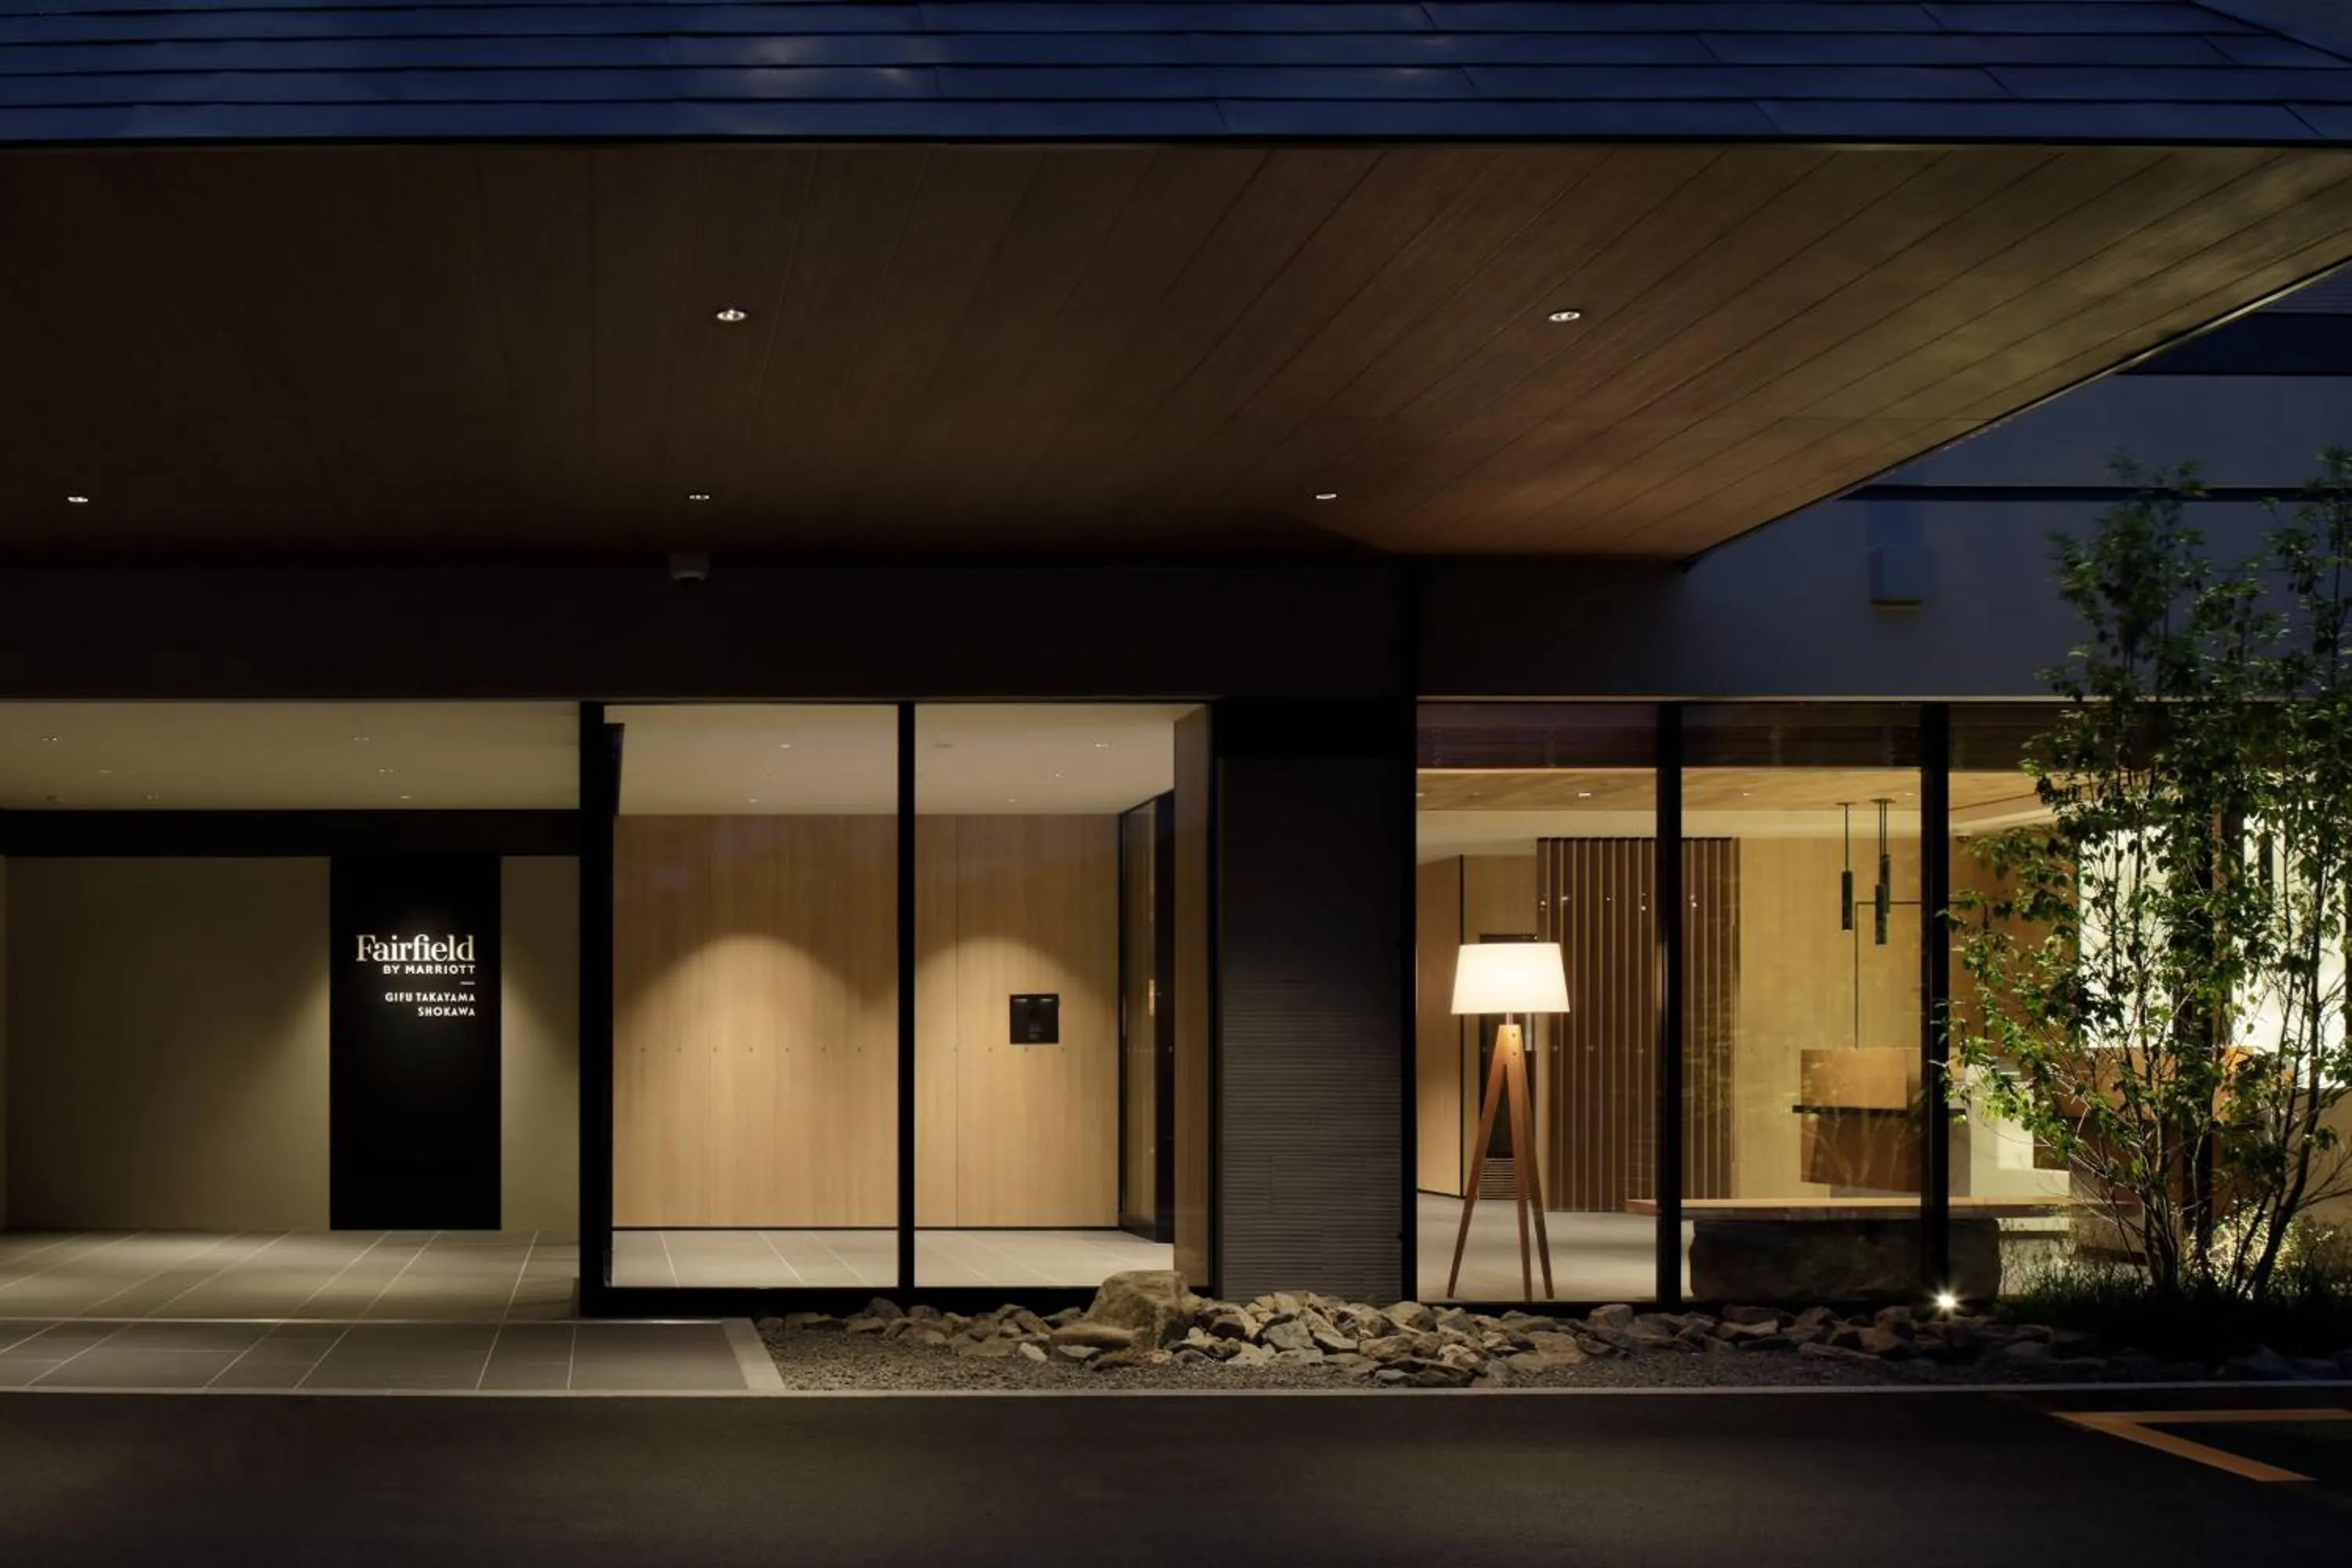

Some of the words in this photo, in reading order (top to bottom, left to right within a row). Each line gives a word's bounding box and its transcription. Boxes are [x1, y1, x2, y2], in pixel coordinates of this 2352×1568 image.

[356, 934, 475, 961] Fairfield
[383, 964, 401, 975] BY
[405, 964, 475, 975] MARRIOTT
[385, 992, 412, 1002] GIFU
[416, 992, 476, 1002] TAKAYAMA
[418, 1007, 475, 1017] SHOKAWA
